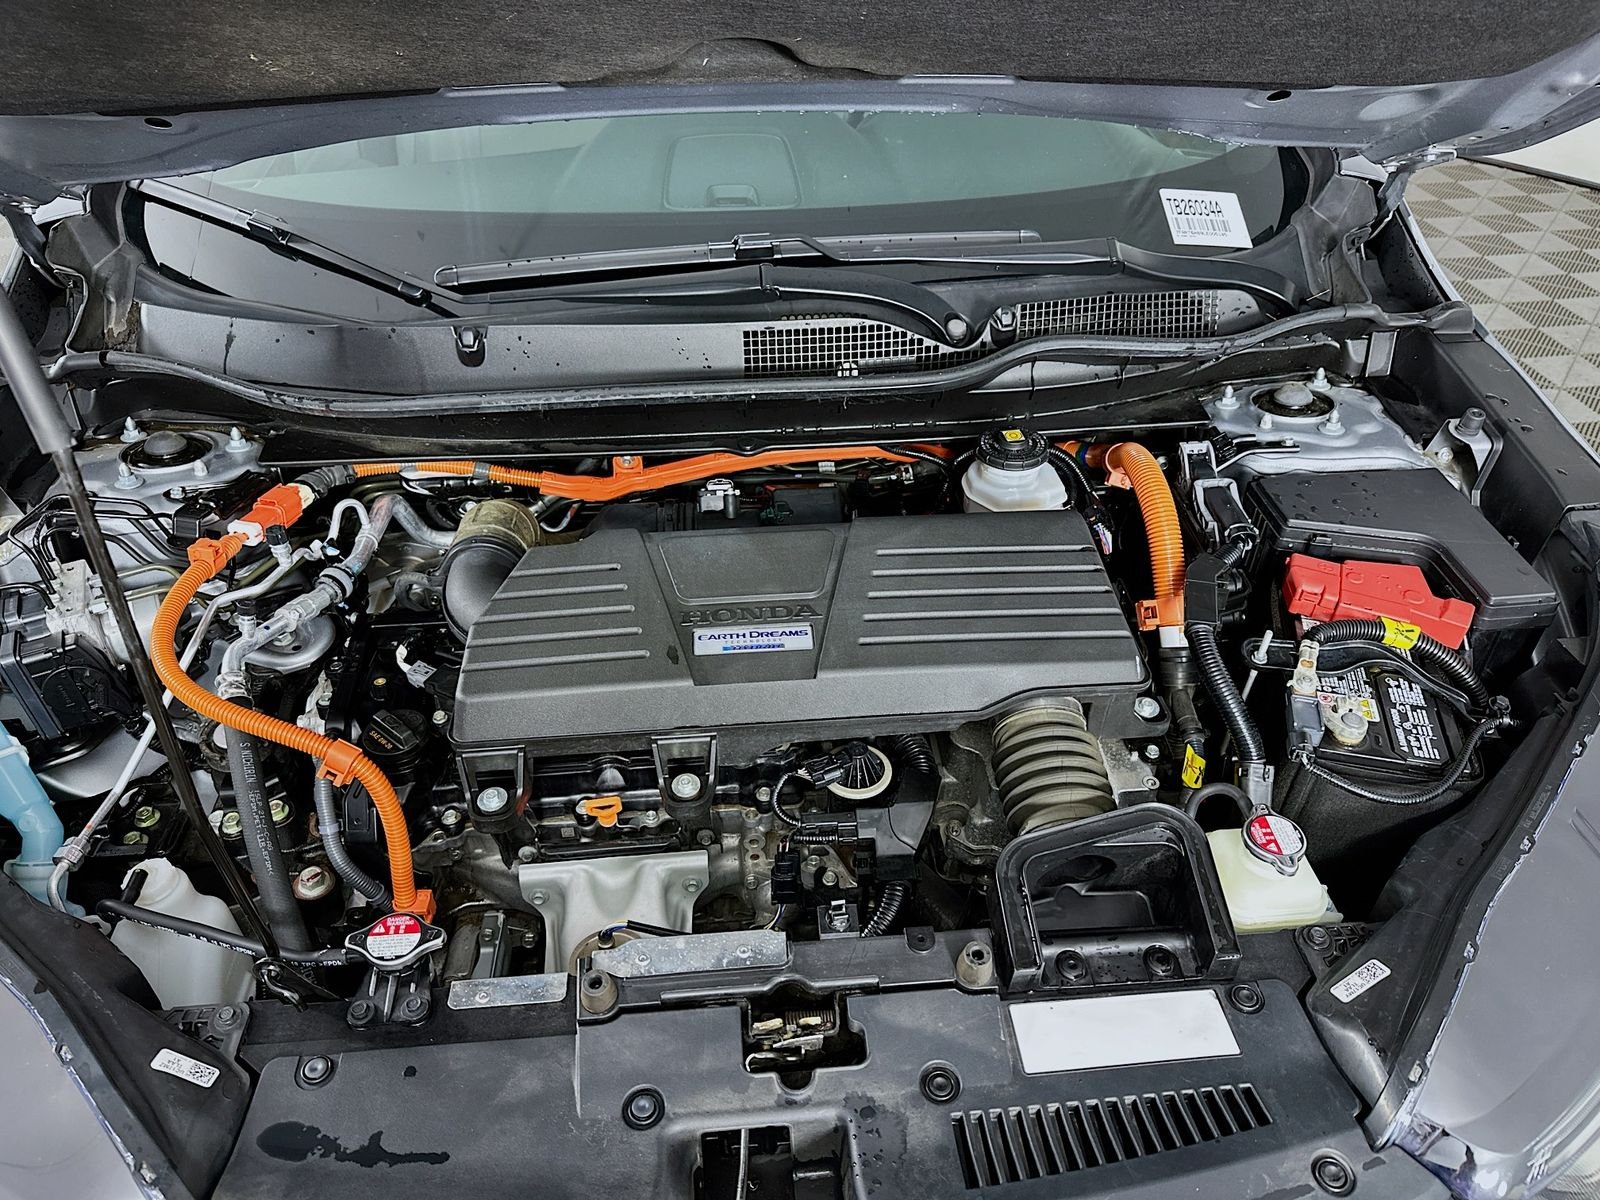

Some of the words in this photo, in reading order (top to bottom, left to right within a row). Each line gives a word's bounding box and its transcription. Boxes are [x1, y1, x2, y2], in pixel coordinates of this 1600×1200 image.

[1166, 198, 1225, 218] TB26034A
[680, 604, 823, 626] HONDA
[697, 630, 746, 642] EARTH
[749, 629, 809, 639] DREAMS
